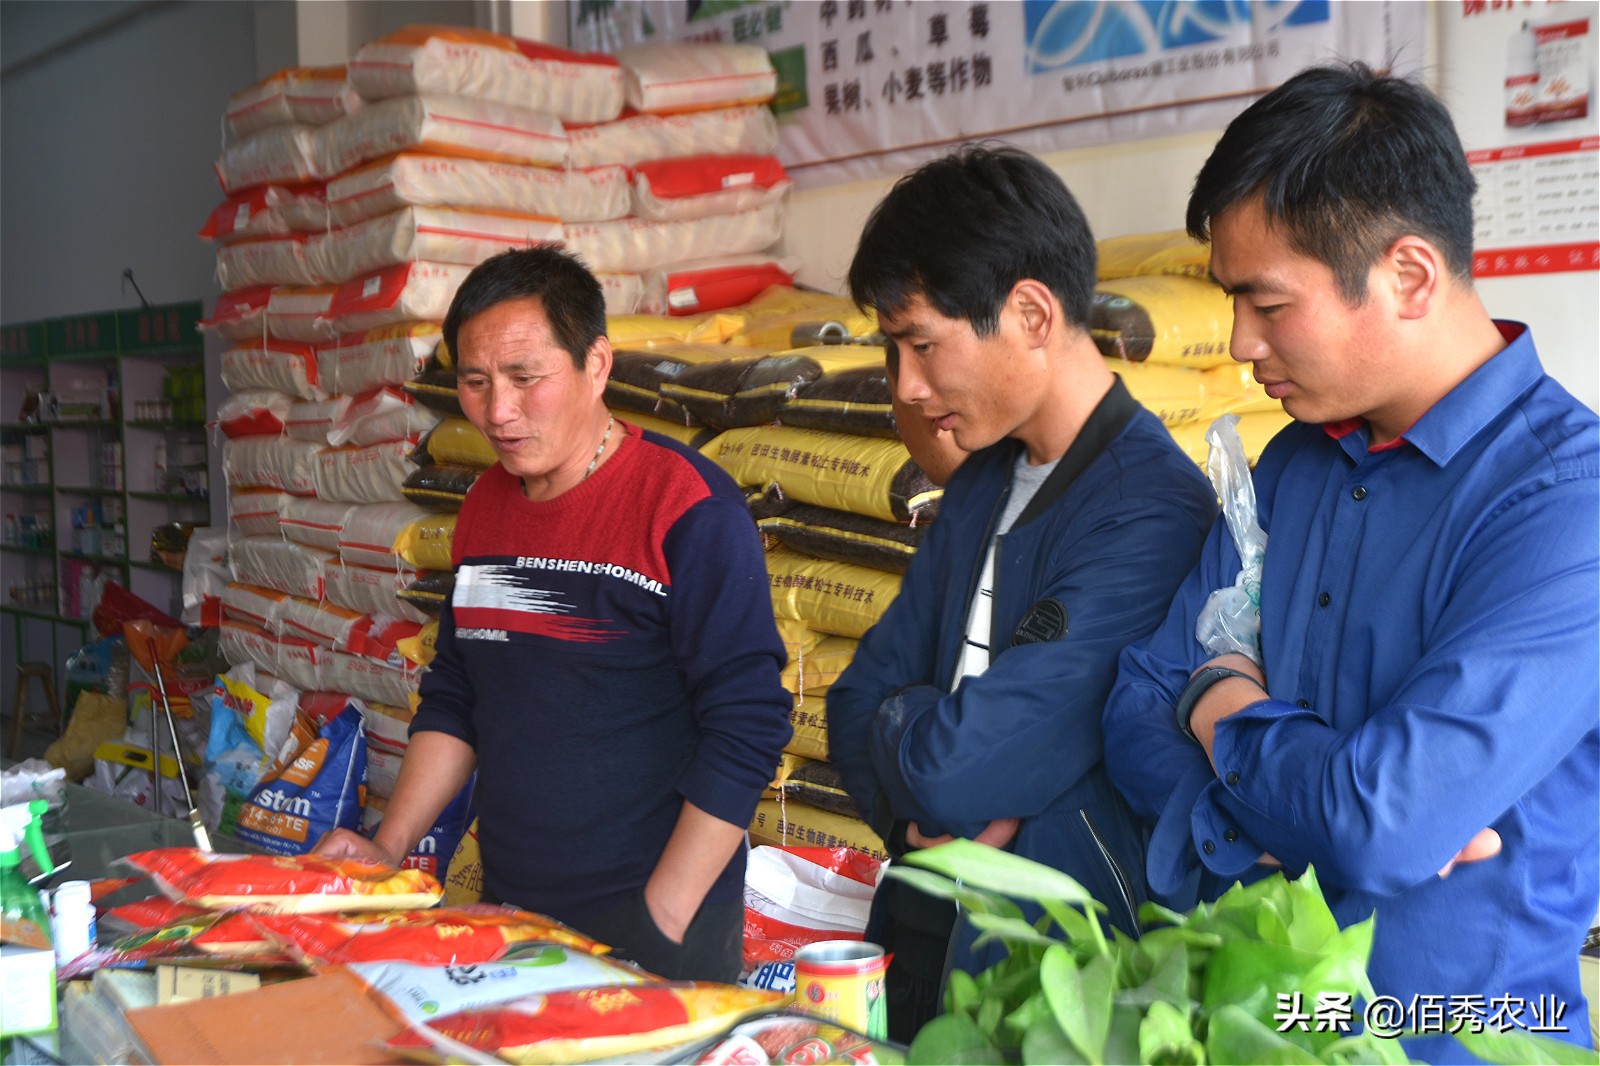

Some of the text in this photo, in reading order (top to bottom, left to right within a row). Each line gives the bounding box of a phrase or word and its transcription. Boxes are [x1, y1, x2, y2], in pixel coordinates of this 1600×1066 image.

[824, 52, 992, 114] 果树、小麦等作物
[750, 442, 871, 478] 芭田生物酵素松土专利技术
[516, 556, 668, 597] BENSHENSHOMML
